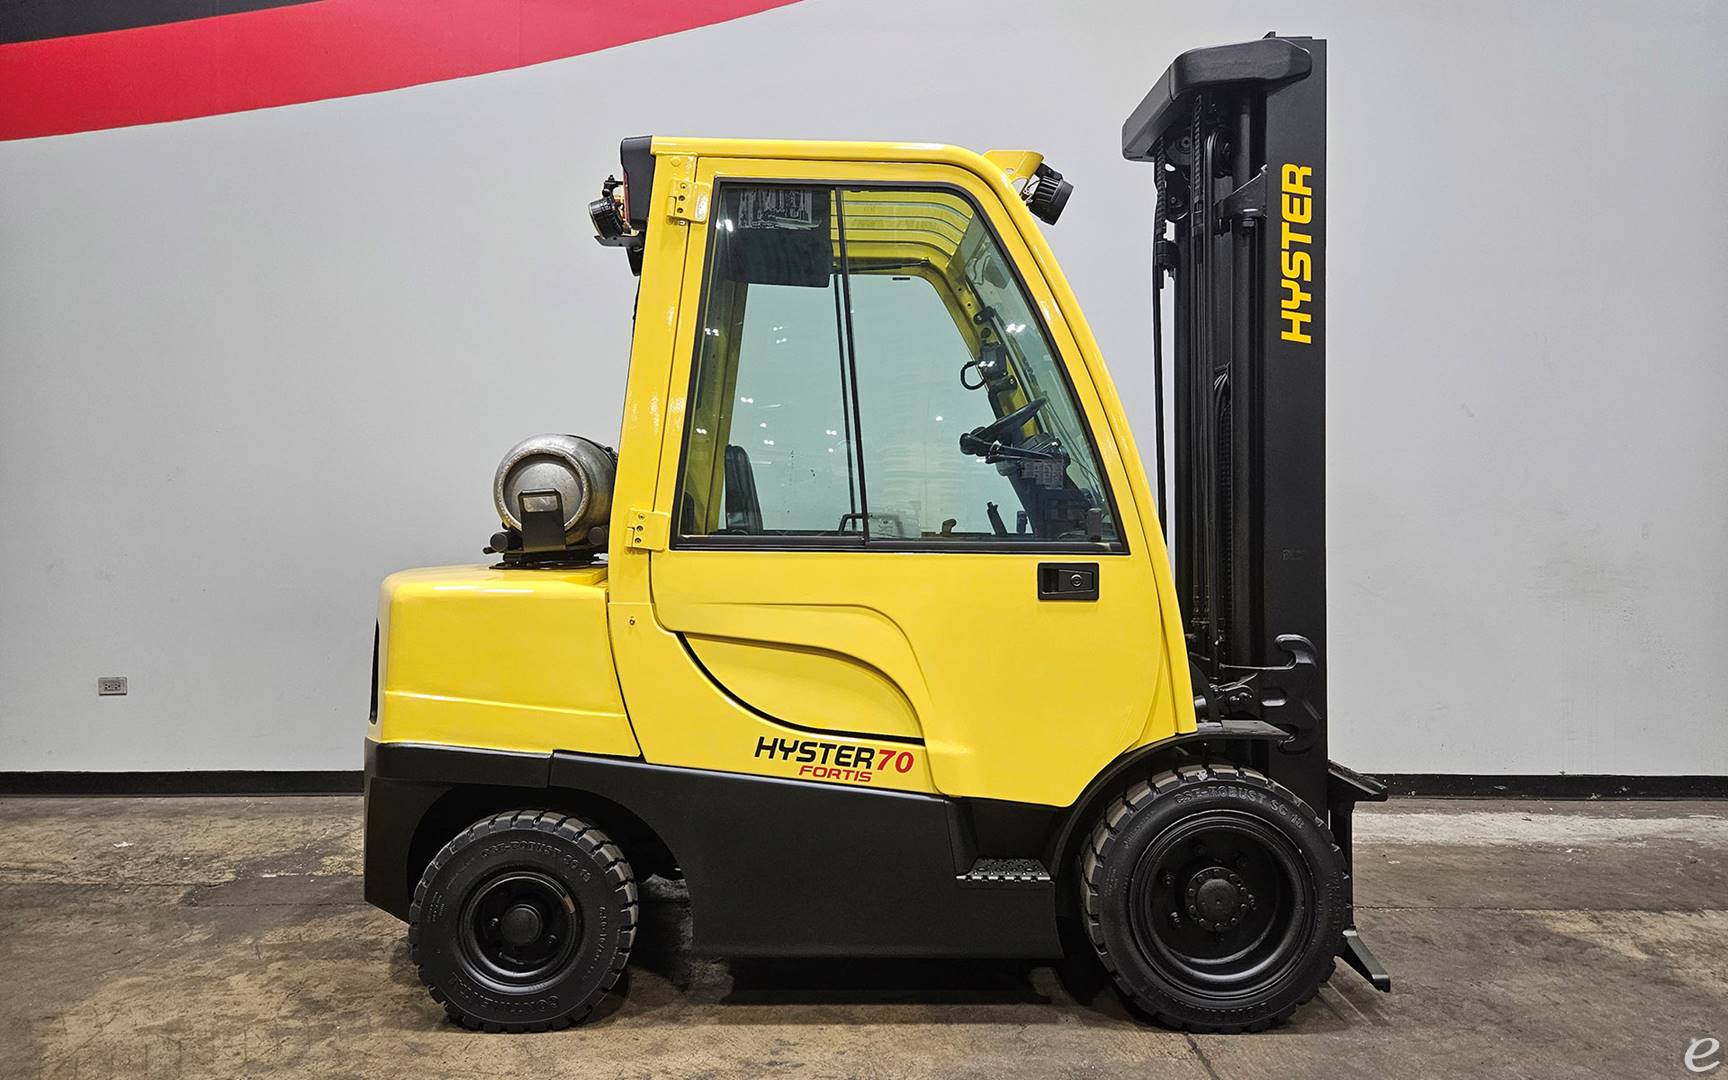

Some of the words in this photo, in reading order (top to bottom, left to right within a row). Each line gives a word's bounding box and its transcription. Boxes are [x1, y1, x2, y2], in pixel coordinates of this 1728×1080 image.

[1281, 163, 1312, 344] HYSTER
[754, 736, 875, 769] HYSTER
[877, 749, 914, 774] 70
[799, 765, 873, 782] FORTIS
